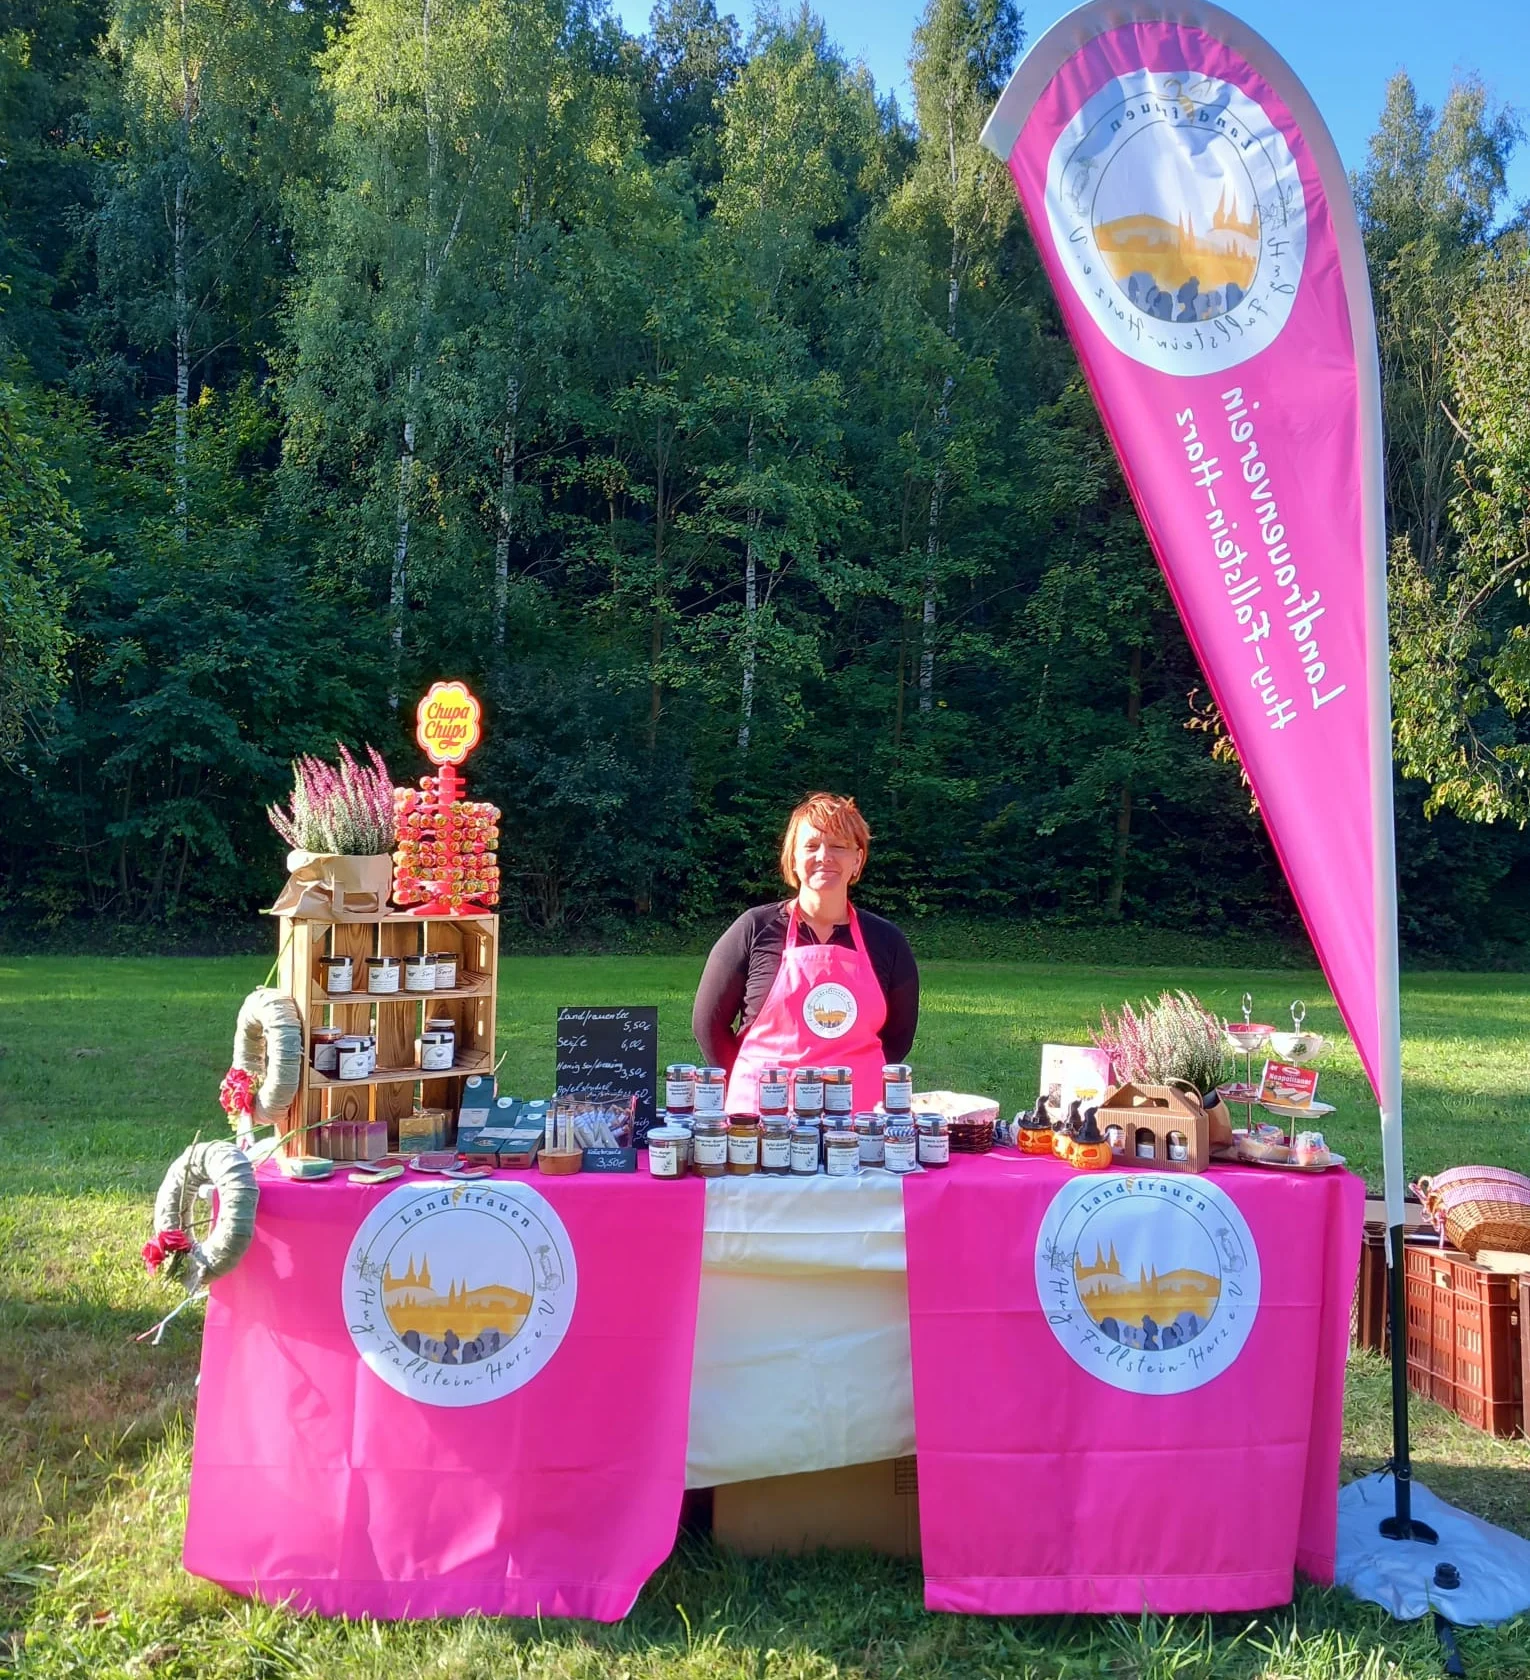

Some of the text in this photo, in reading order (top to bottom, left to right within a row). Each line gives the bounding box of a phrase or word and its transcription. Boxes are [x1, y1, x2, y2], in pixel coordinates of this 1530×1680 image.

[427, 702, 471, 724] Chupa
[425, 720, 468, 749] Chups
[557, 1008, 630, 1027] Landfrauentee
[623, 1020, 651, 1033] 5,50€
[556, 1035, 588, 1054] Seife
[620, 1067, 649, 1080] 3,50€
[596, 1157, 627, 1169] 3,50€
